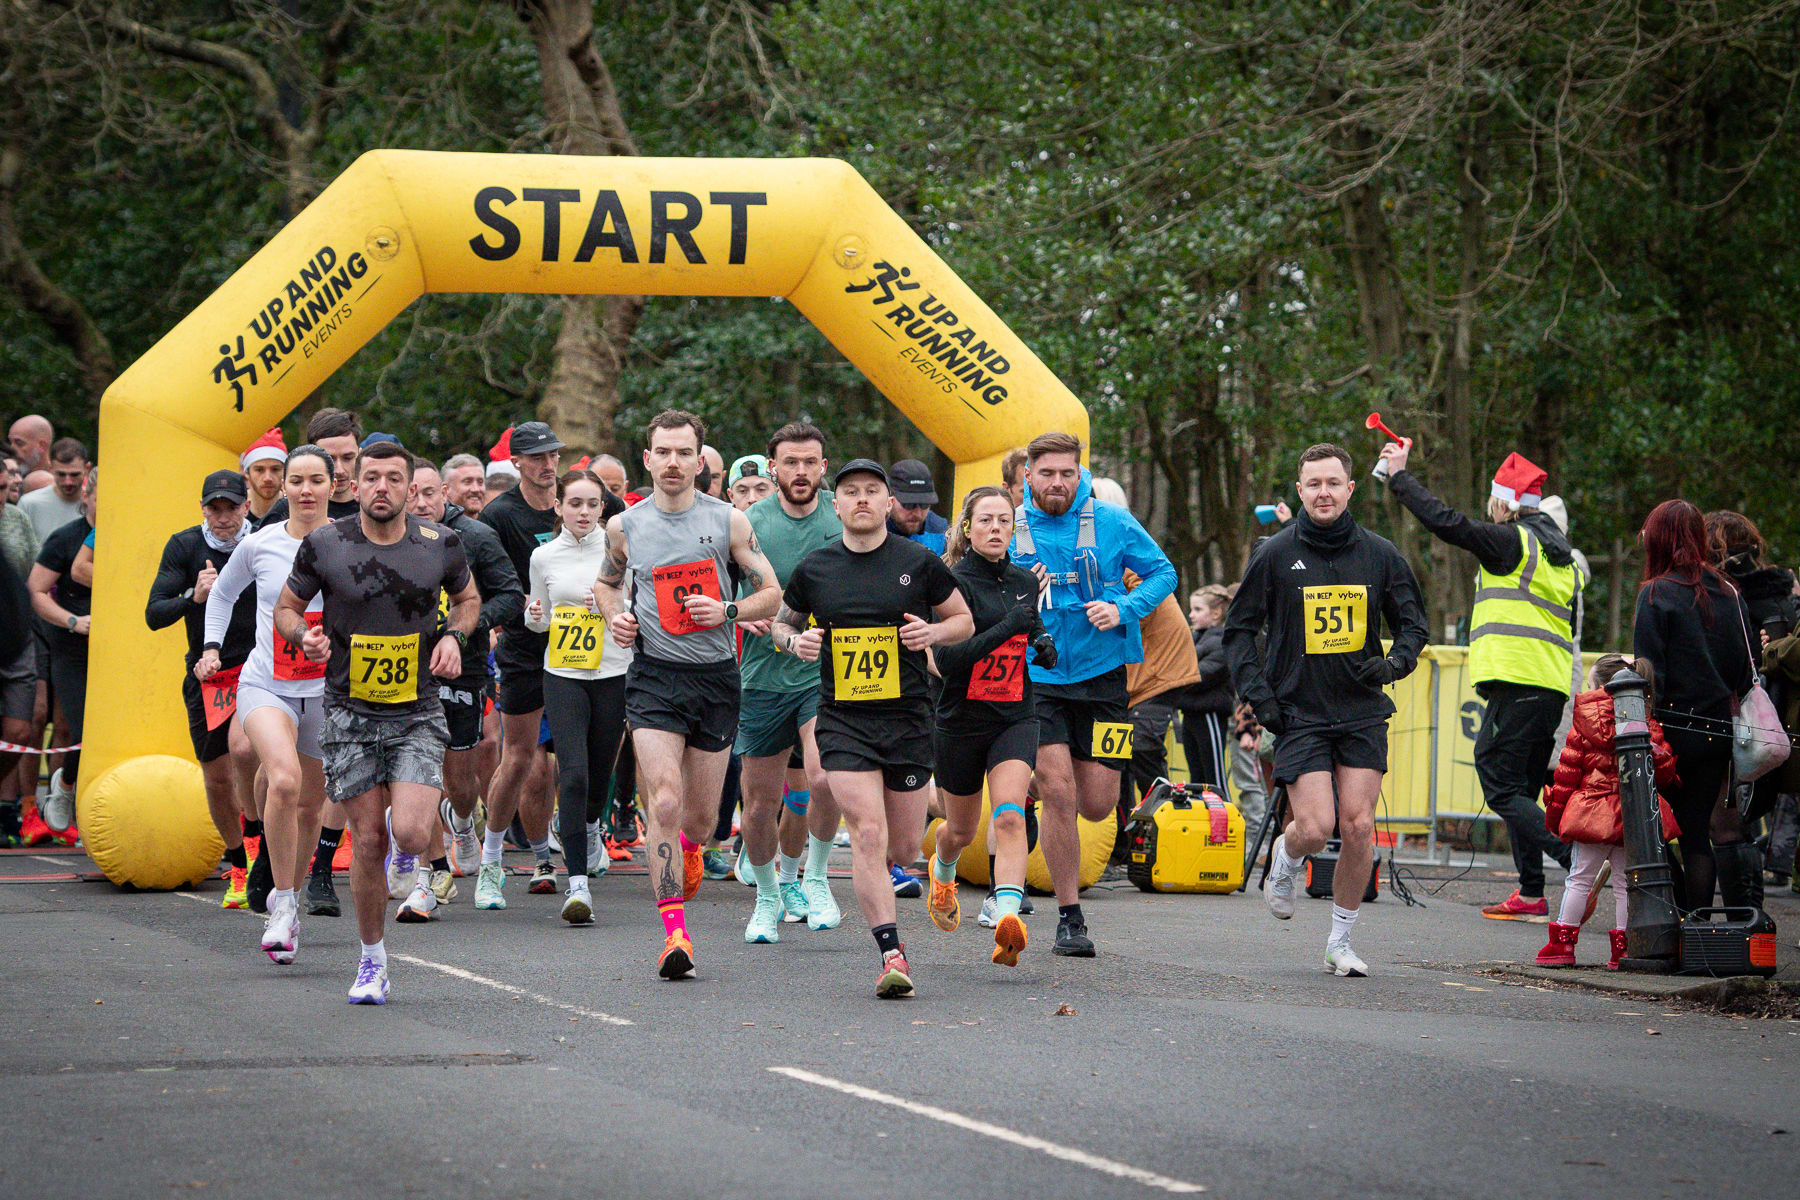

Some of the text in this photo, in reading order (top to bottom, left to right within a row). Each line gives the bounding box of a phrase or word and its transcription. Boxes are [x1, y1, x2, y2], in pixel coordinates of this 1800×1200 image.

[469, 186, 767, 264] START
[249, 246, 336, 339] UP AND
[257, 252, 368, 373] RUNNING
[302, 303, 352, 339] EVENTS
[919, 292, 1010, 374] UP AND
[885, 302, 1008, 405] RUNNING
[900, 347, 958, 394] EVENTS
[688, 566, 714, 577] vybey
[1338, 591, 1364, 600] vybey
[580, 613, 603, 622] vybey
[1314, 606, 1354, 634] 551
[391, 642, 416, 652] vybey
[556, 624, 596, 652] 726
[867, 634, 894, 644] vybey
[361, 657, 409, 686] 738
[842, 650, 888, 680] 749
[980, 654, 1022, 682] 257
